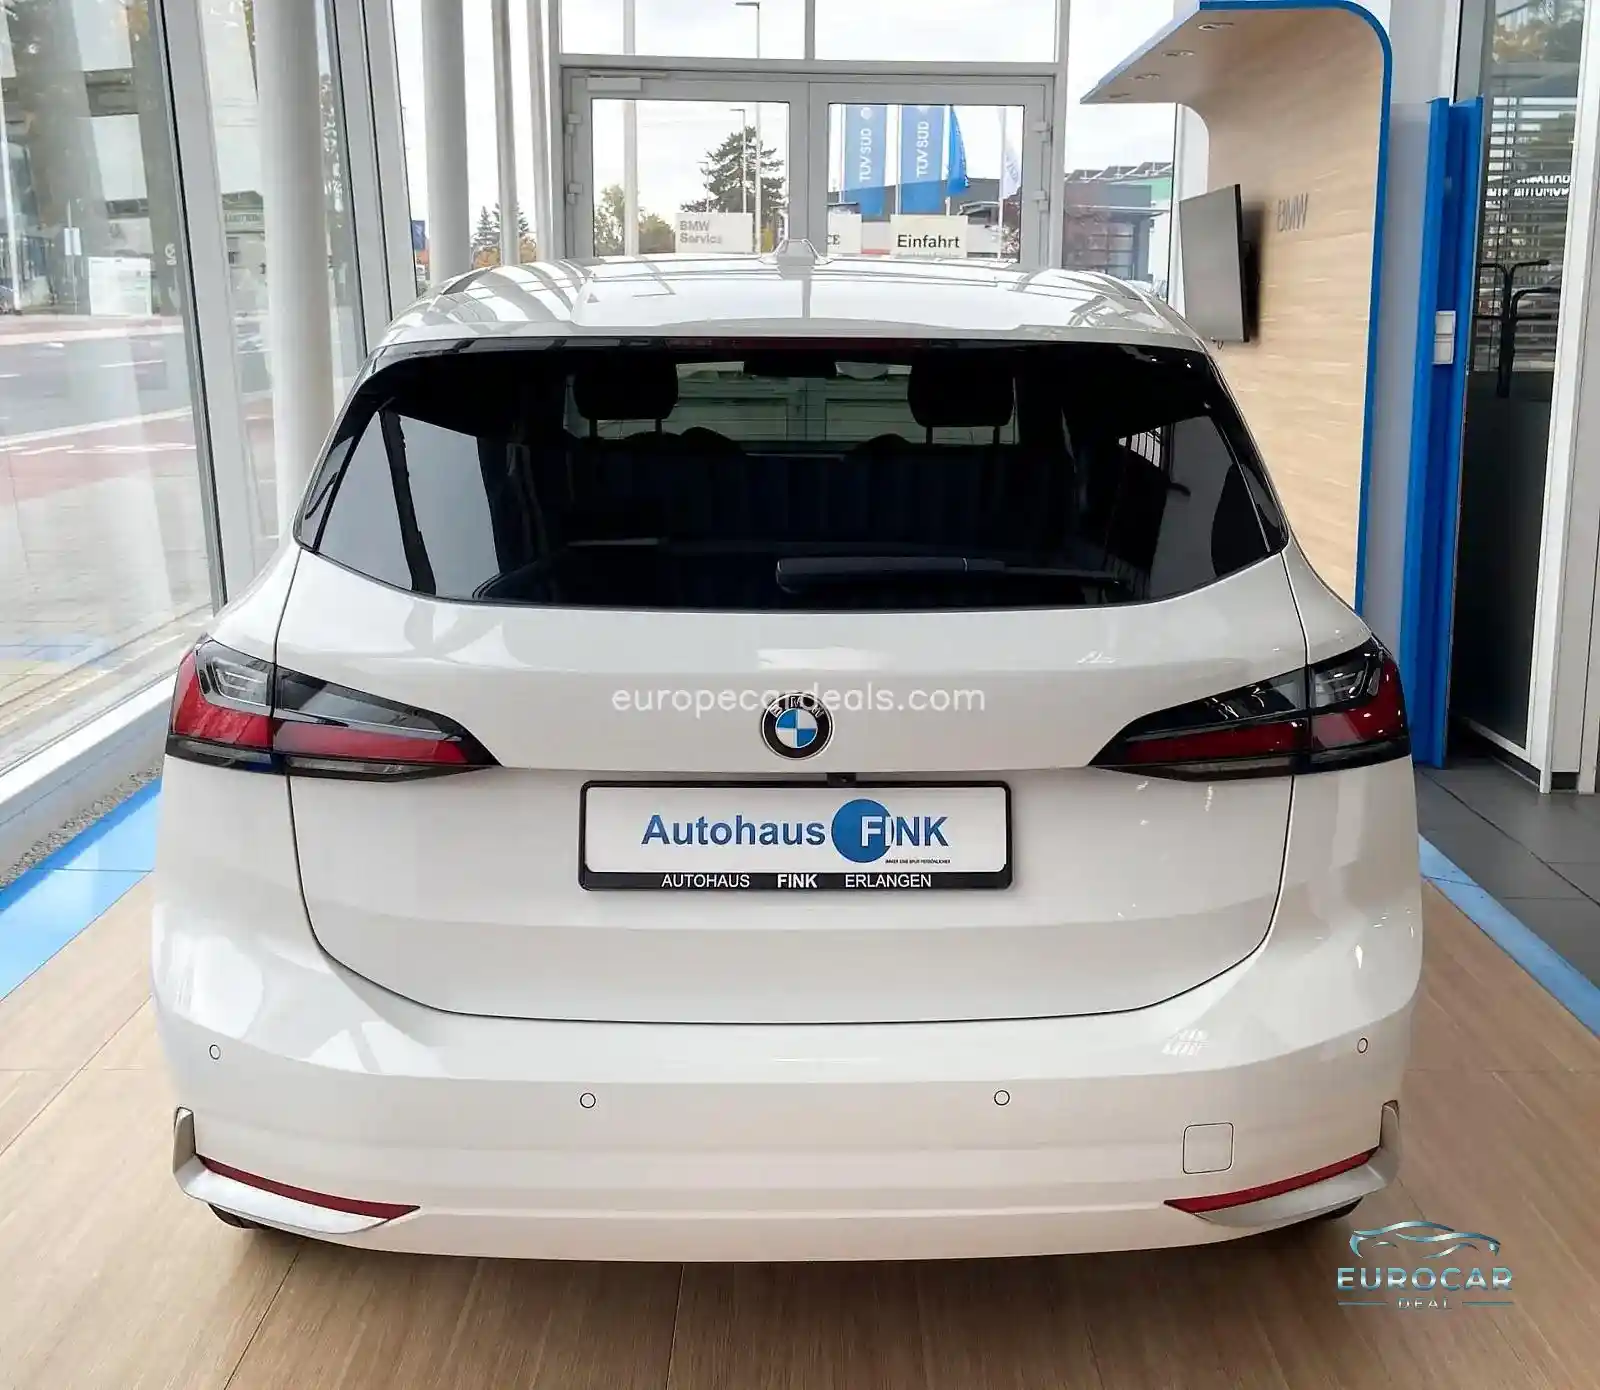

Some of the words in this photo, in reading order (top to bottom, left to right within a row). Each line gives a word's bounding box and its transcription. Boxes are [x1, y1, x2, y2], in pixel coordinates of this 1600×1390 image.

[1276, 192, 1309, 231] BMW
[679, 219, 710, 232] BMW
[897, 233, 961, 249] Einfahrt
[769, 695, 826, 718] BMW
[641, 814, 827, 846] Autohaus
[860, 816, 949, 848] FINK
[661, 873, 751, 889] AUTOHAUS
[776, 873, 818, 889] FINK
[844, 873, 932, 889] ERLANGEN
